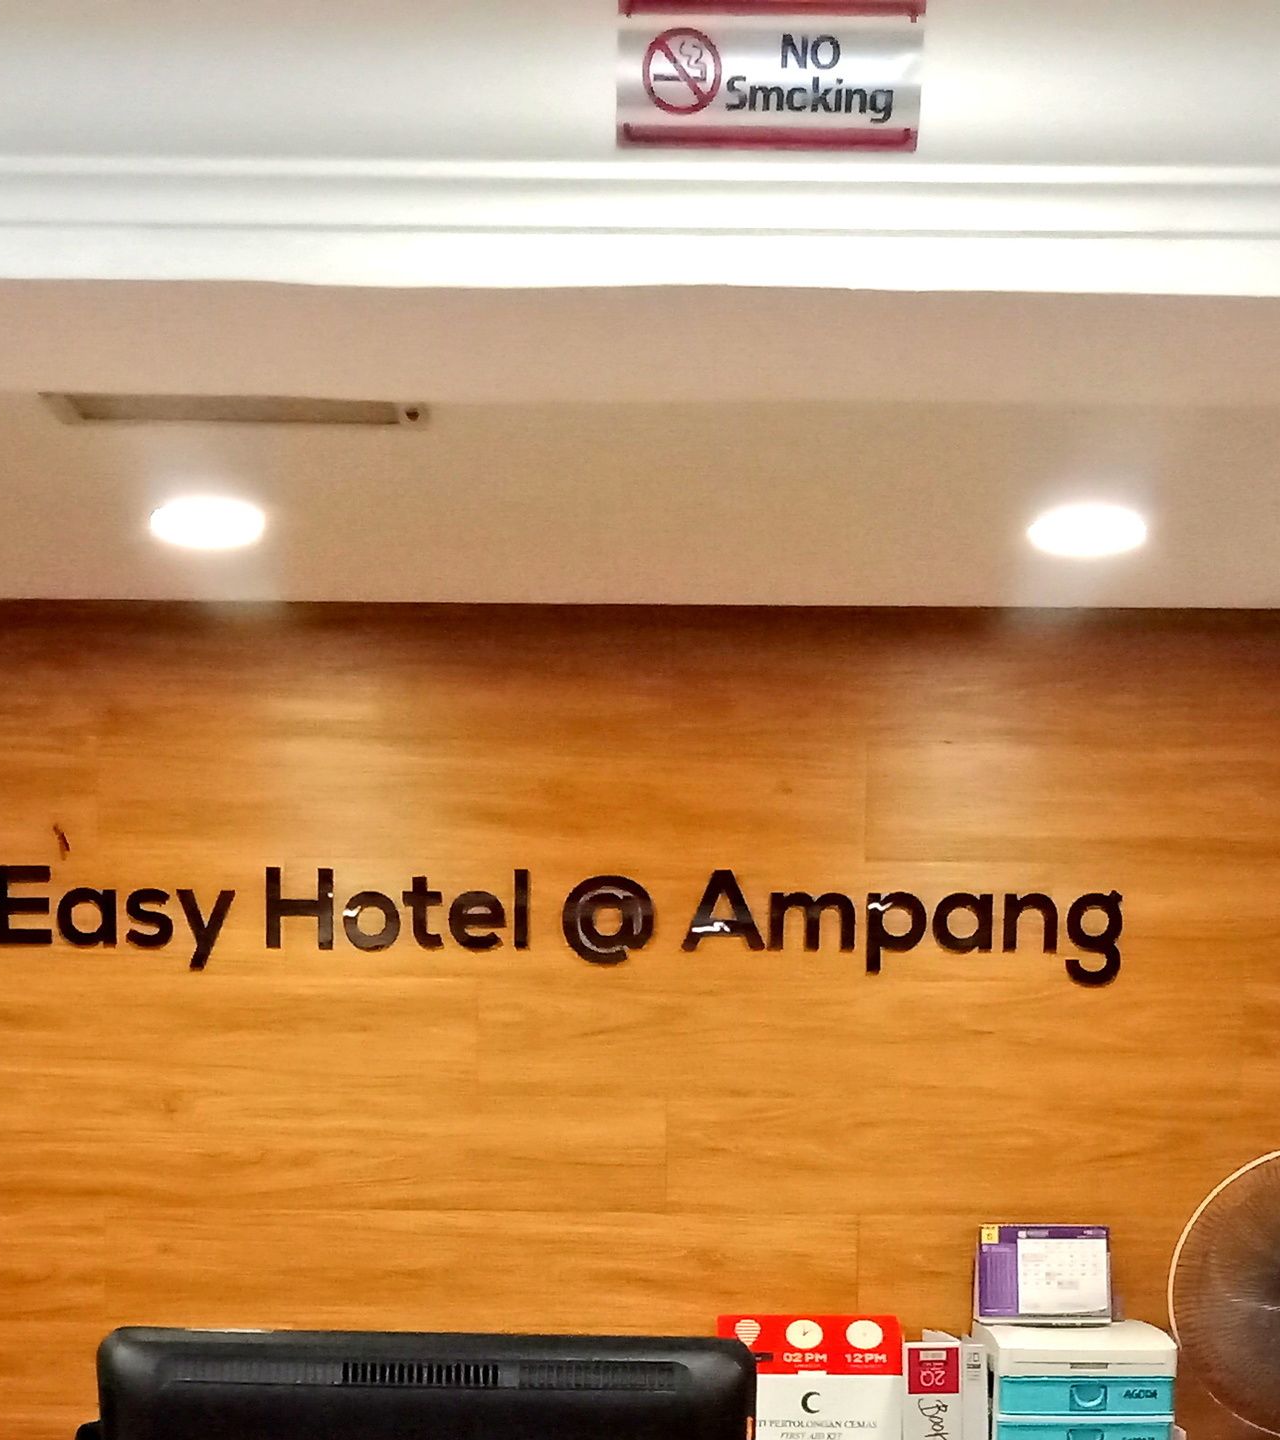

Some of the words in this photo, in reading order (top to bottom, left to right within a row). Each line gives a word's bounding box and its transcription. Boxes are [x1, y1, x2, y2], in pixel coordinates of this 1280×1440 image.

[780, 33, 841, 69] NO
[724, 76, 894, 123] Smoking
[265, 866, 529, 952] Hotel
[562, 874, 655, 965] @
[681, 869, 1123, 987] Ampang
[782, 1352, 803, 1363] 02
[804, 1352, 828, 1363] PM
[844, 1353, 863, 1364] 12
[864, 1353, 888, 1364] PM
